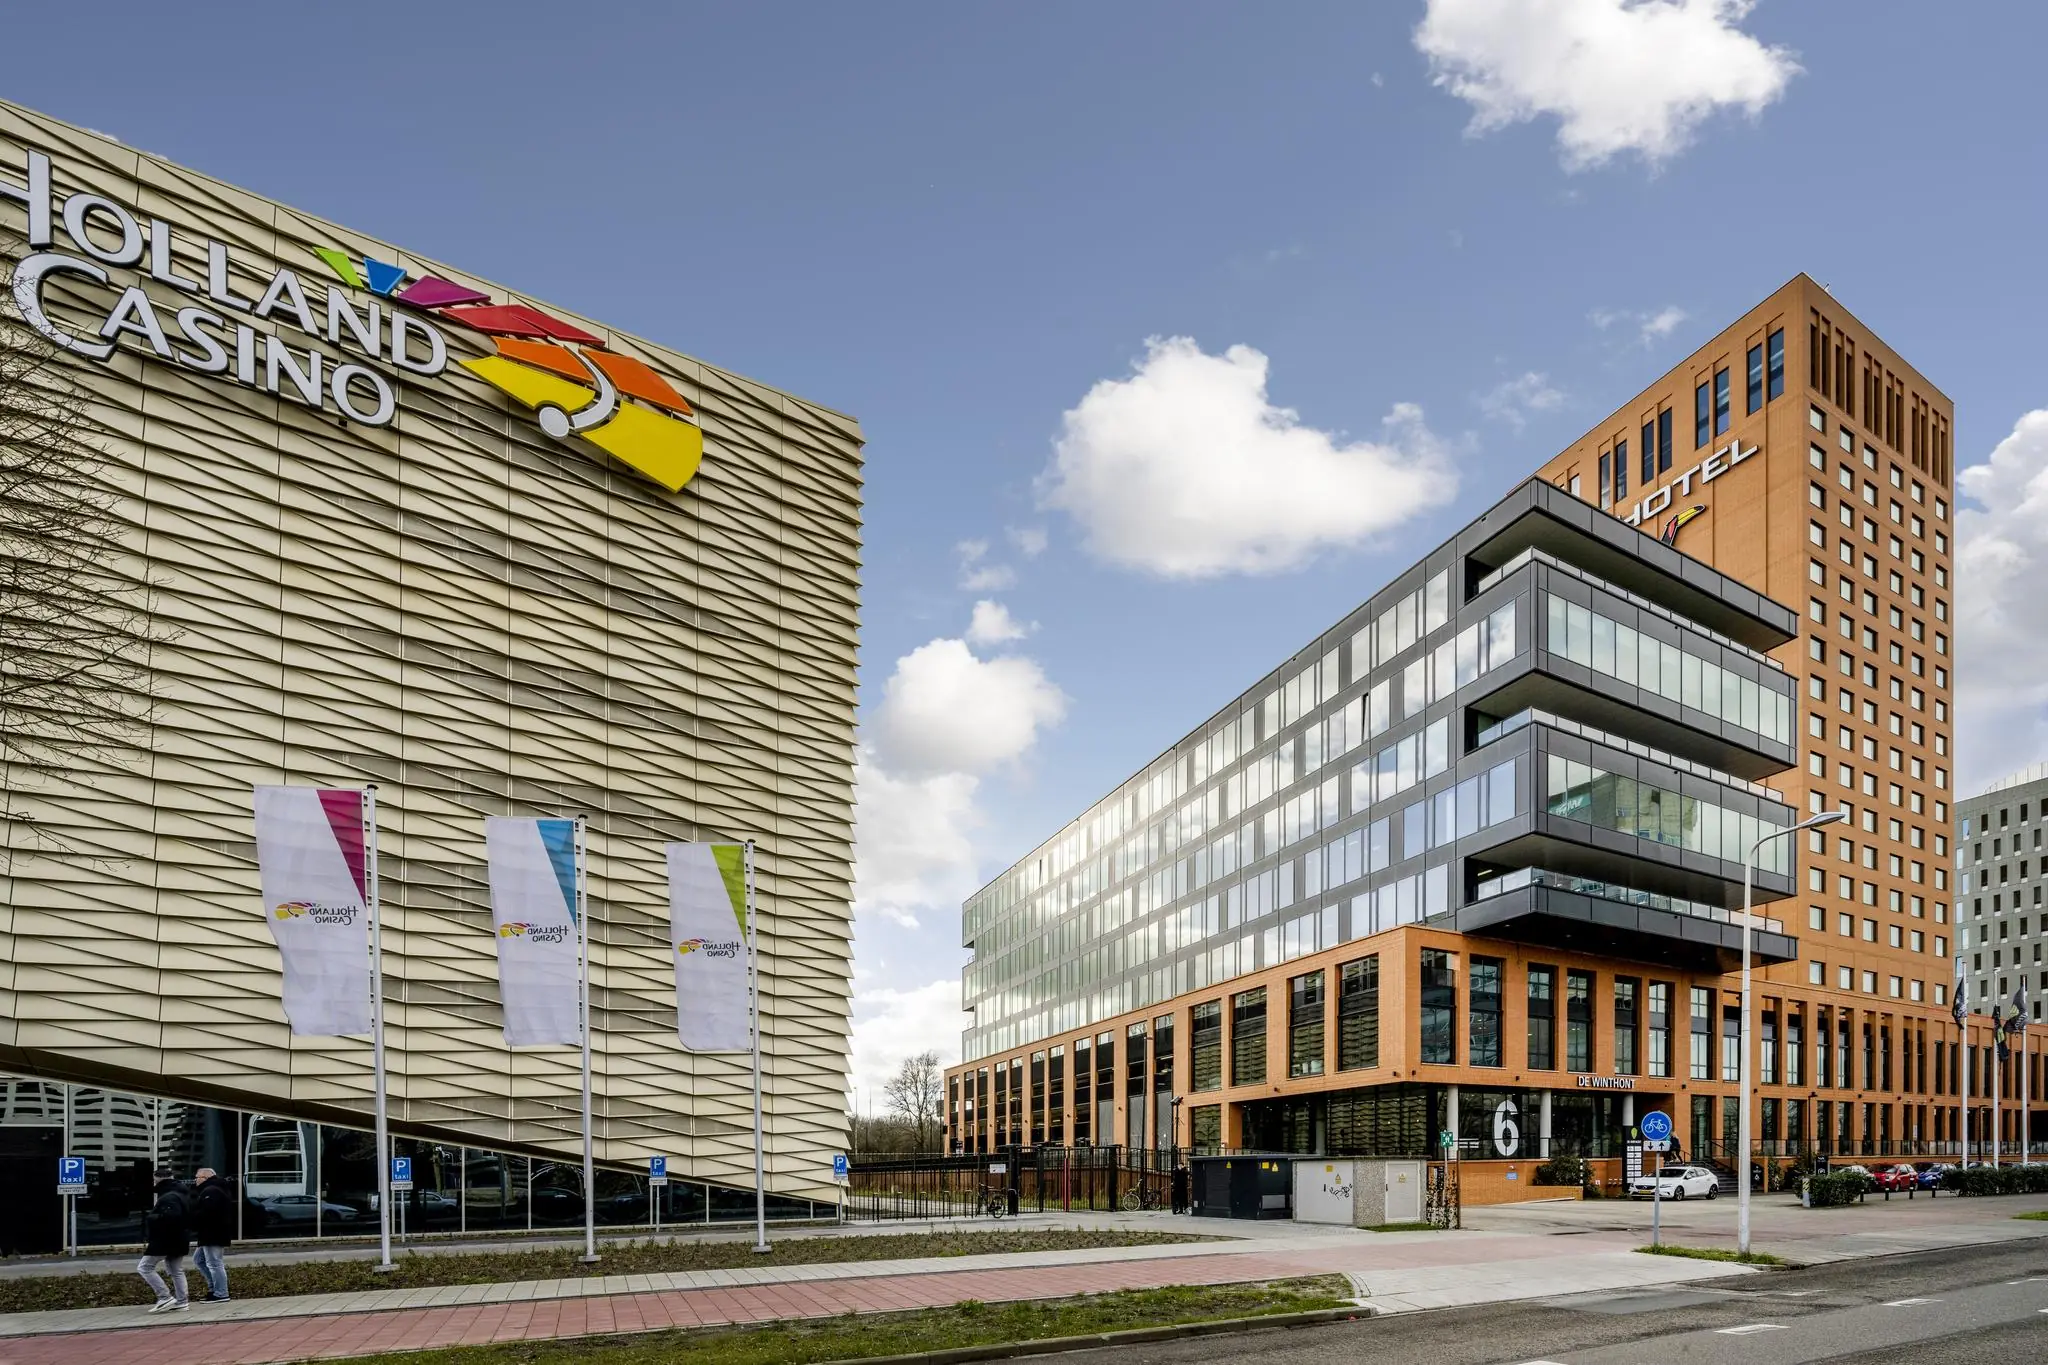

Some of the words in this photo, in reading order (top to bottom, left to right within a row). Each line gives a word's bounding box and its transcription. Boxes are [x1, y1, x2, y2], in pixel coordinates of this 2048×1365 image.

[11, 251, 396, 428] CASINO
[1578, 1076, 1590, 1087] DE
[1592, 1076, 1636, 1089] WINTHONT
[1494, 1100, 1519, 1157] 6
[65, 1160, 79, 1173] P
[396, 1160, 407, 1172] P
[654, 1159, 663, 1169] P
[836, 1157, 844, 1167] P
